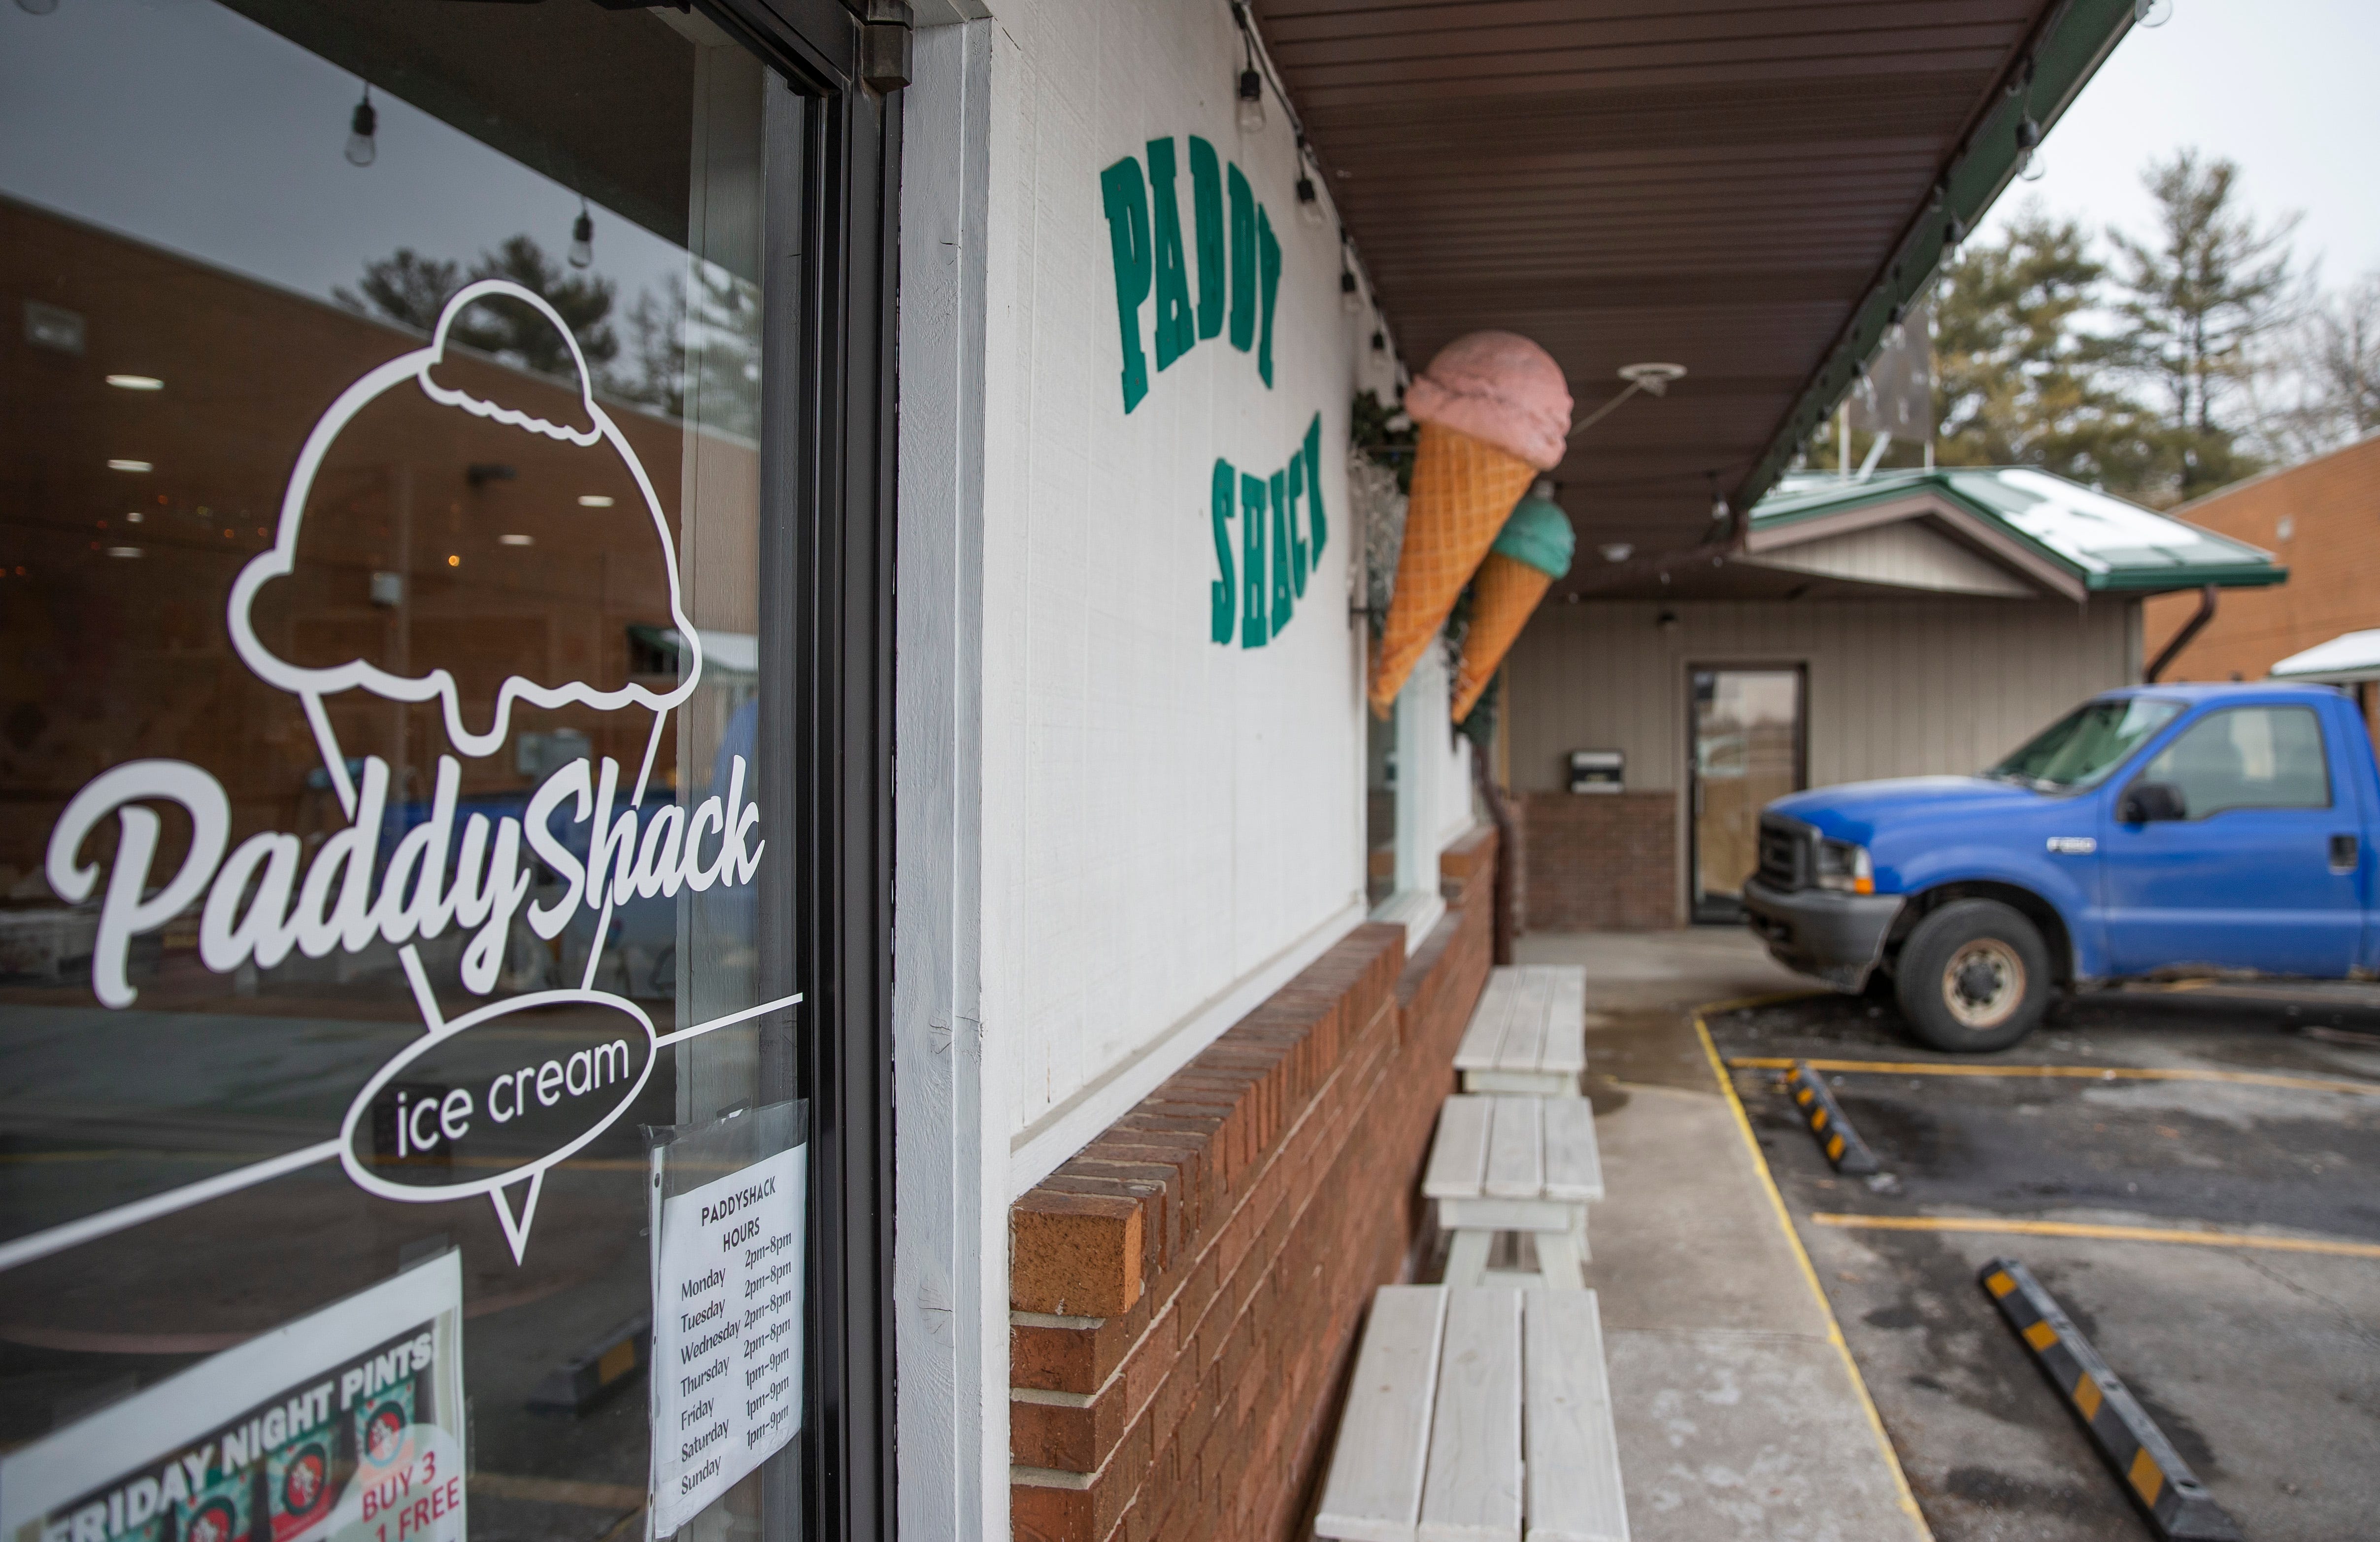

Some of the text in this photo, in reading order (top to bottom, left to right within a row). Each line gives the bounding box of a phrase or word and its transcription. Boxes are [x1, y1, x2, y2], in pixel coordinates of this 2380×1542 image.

[1100, 134, 1282, 415] PADDY
[1211, 410, 1328, 650] SHACK
[397, 1039, 629, 1158] ice cream
[702, 1175, 776, 1227] PADDYSHACK
[723, 1216, 760, 1252] HOURS
[681, 1232, 792, 1301] Monday 2pm-8pm
[681, 1261, 791, 1333] Tuesday 2pm-8pm
[680, 1318, 791, 1398] Thursday 2pm-8pm
[681, 1290, 791, 1365] Wednesday 2pm-8pm
[221, 1381, 335, 1476] NIGHT
[341, 1332, 432, 1411] PINTS
[681, 1347, 789, 1431] Friday 1pm-9pm
[681, 1376, 789, 1463] Saturday 1pm-9pm
[362, 1450, 436, 1523] BUY 3
[681, 1405, 789, 1495] Sunday 1pm-9pm
[399, 1475, 460, 1542] FREE
